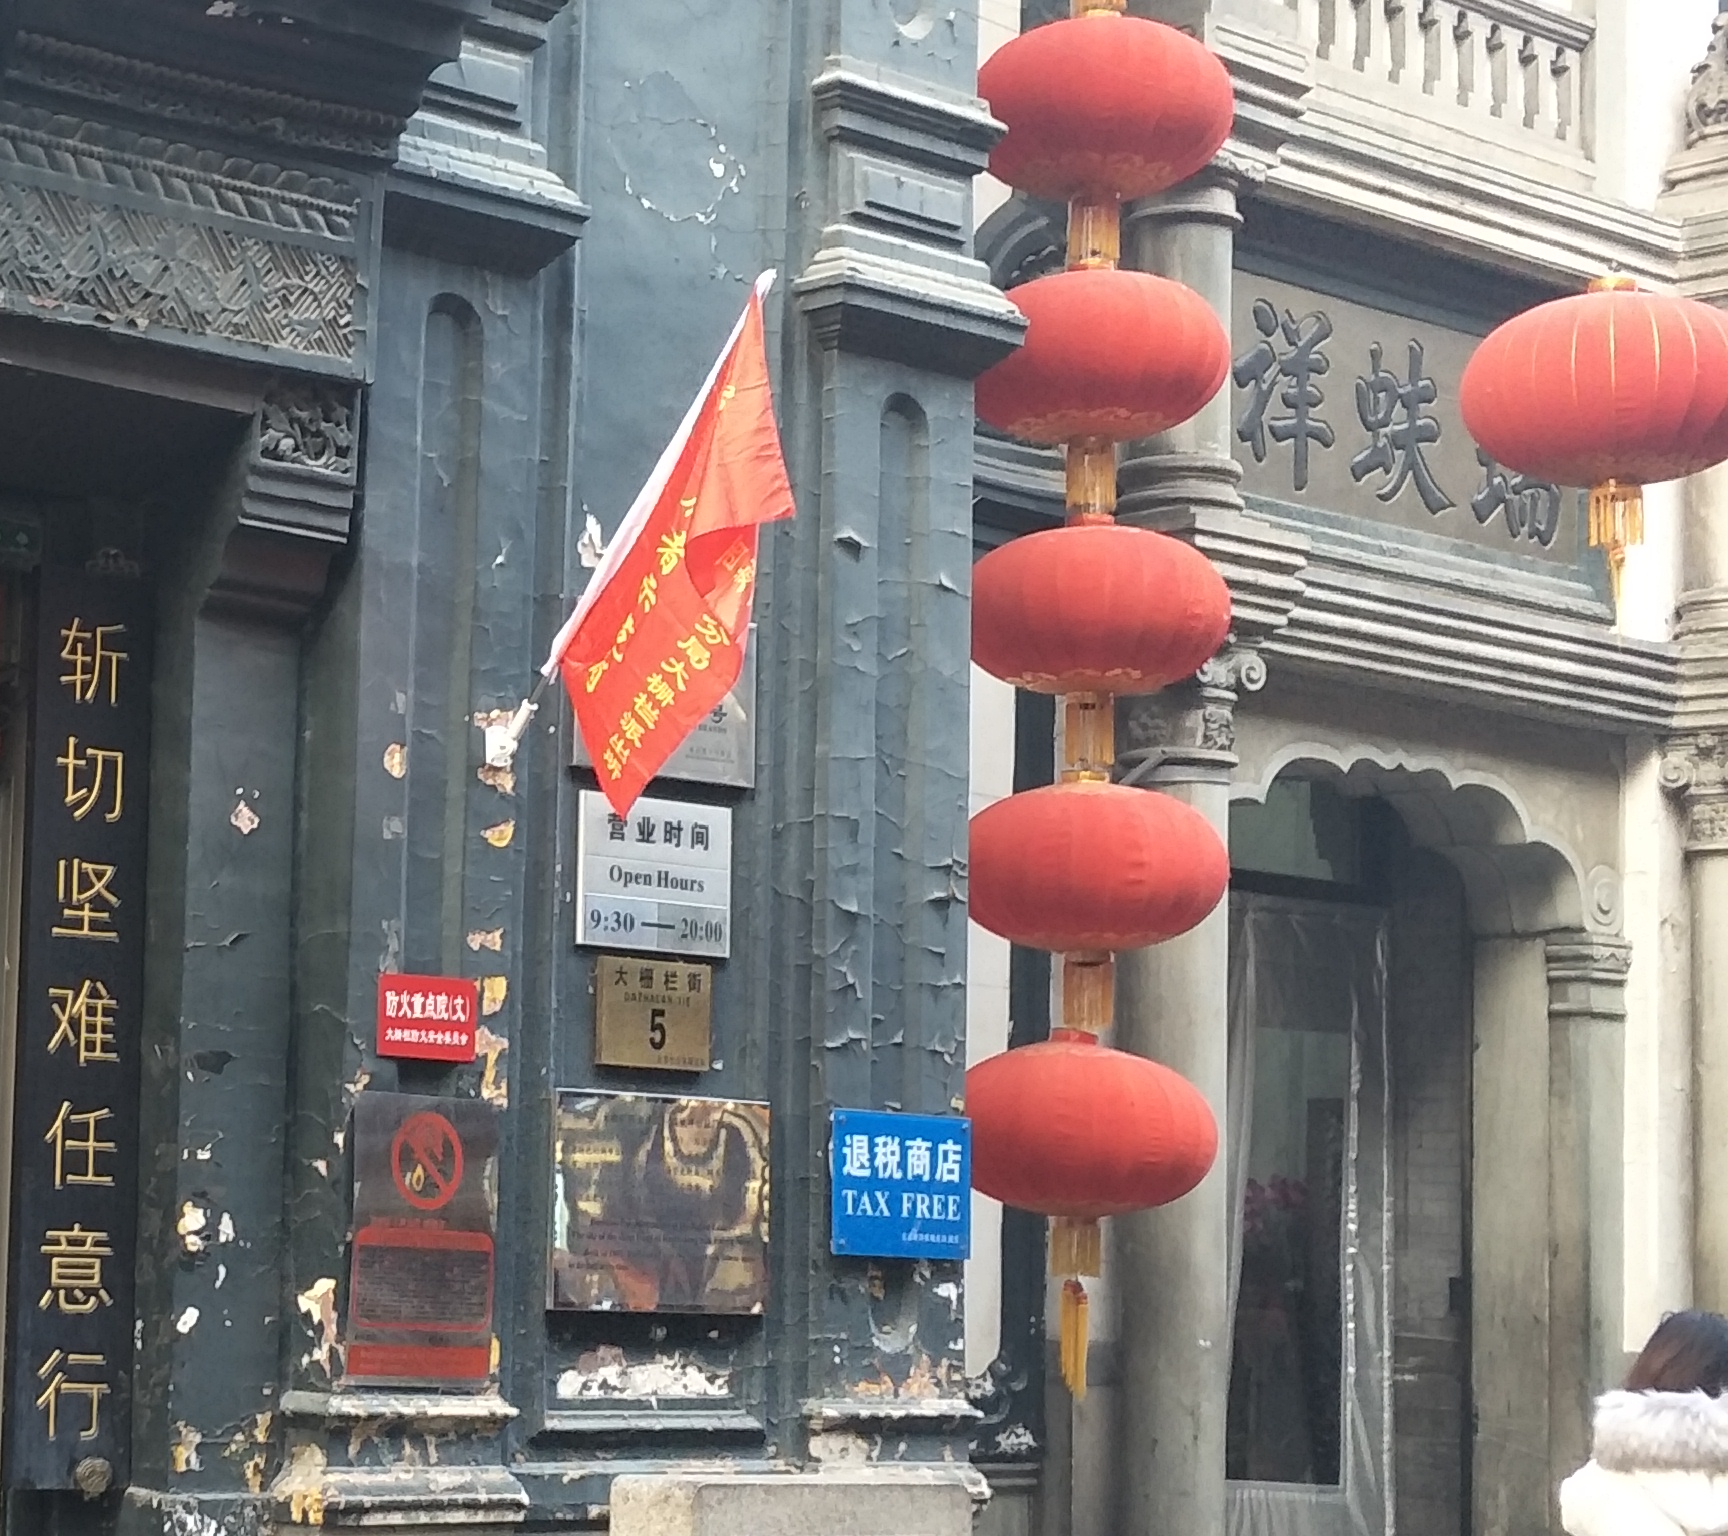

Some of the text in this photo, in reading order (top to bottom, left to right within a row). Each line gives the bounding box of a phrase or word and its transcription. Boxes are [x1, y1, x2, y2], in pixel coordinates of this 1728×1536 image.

[607, 812, 710, 852] 营业时间
[609, 864, 705, 893] Open Hours
[590, 909, 636, 933] 9:30
[680, 917, 723, 943] 20:00
[35, 616, 130, 1442] 斩切坚难任意行
[649, 1008, 666, 1050] 5
[841, 1133, 963, 1184] 退税商店
[841, 1189, 962, 1221] TAX FREE
